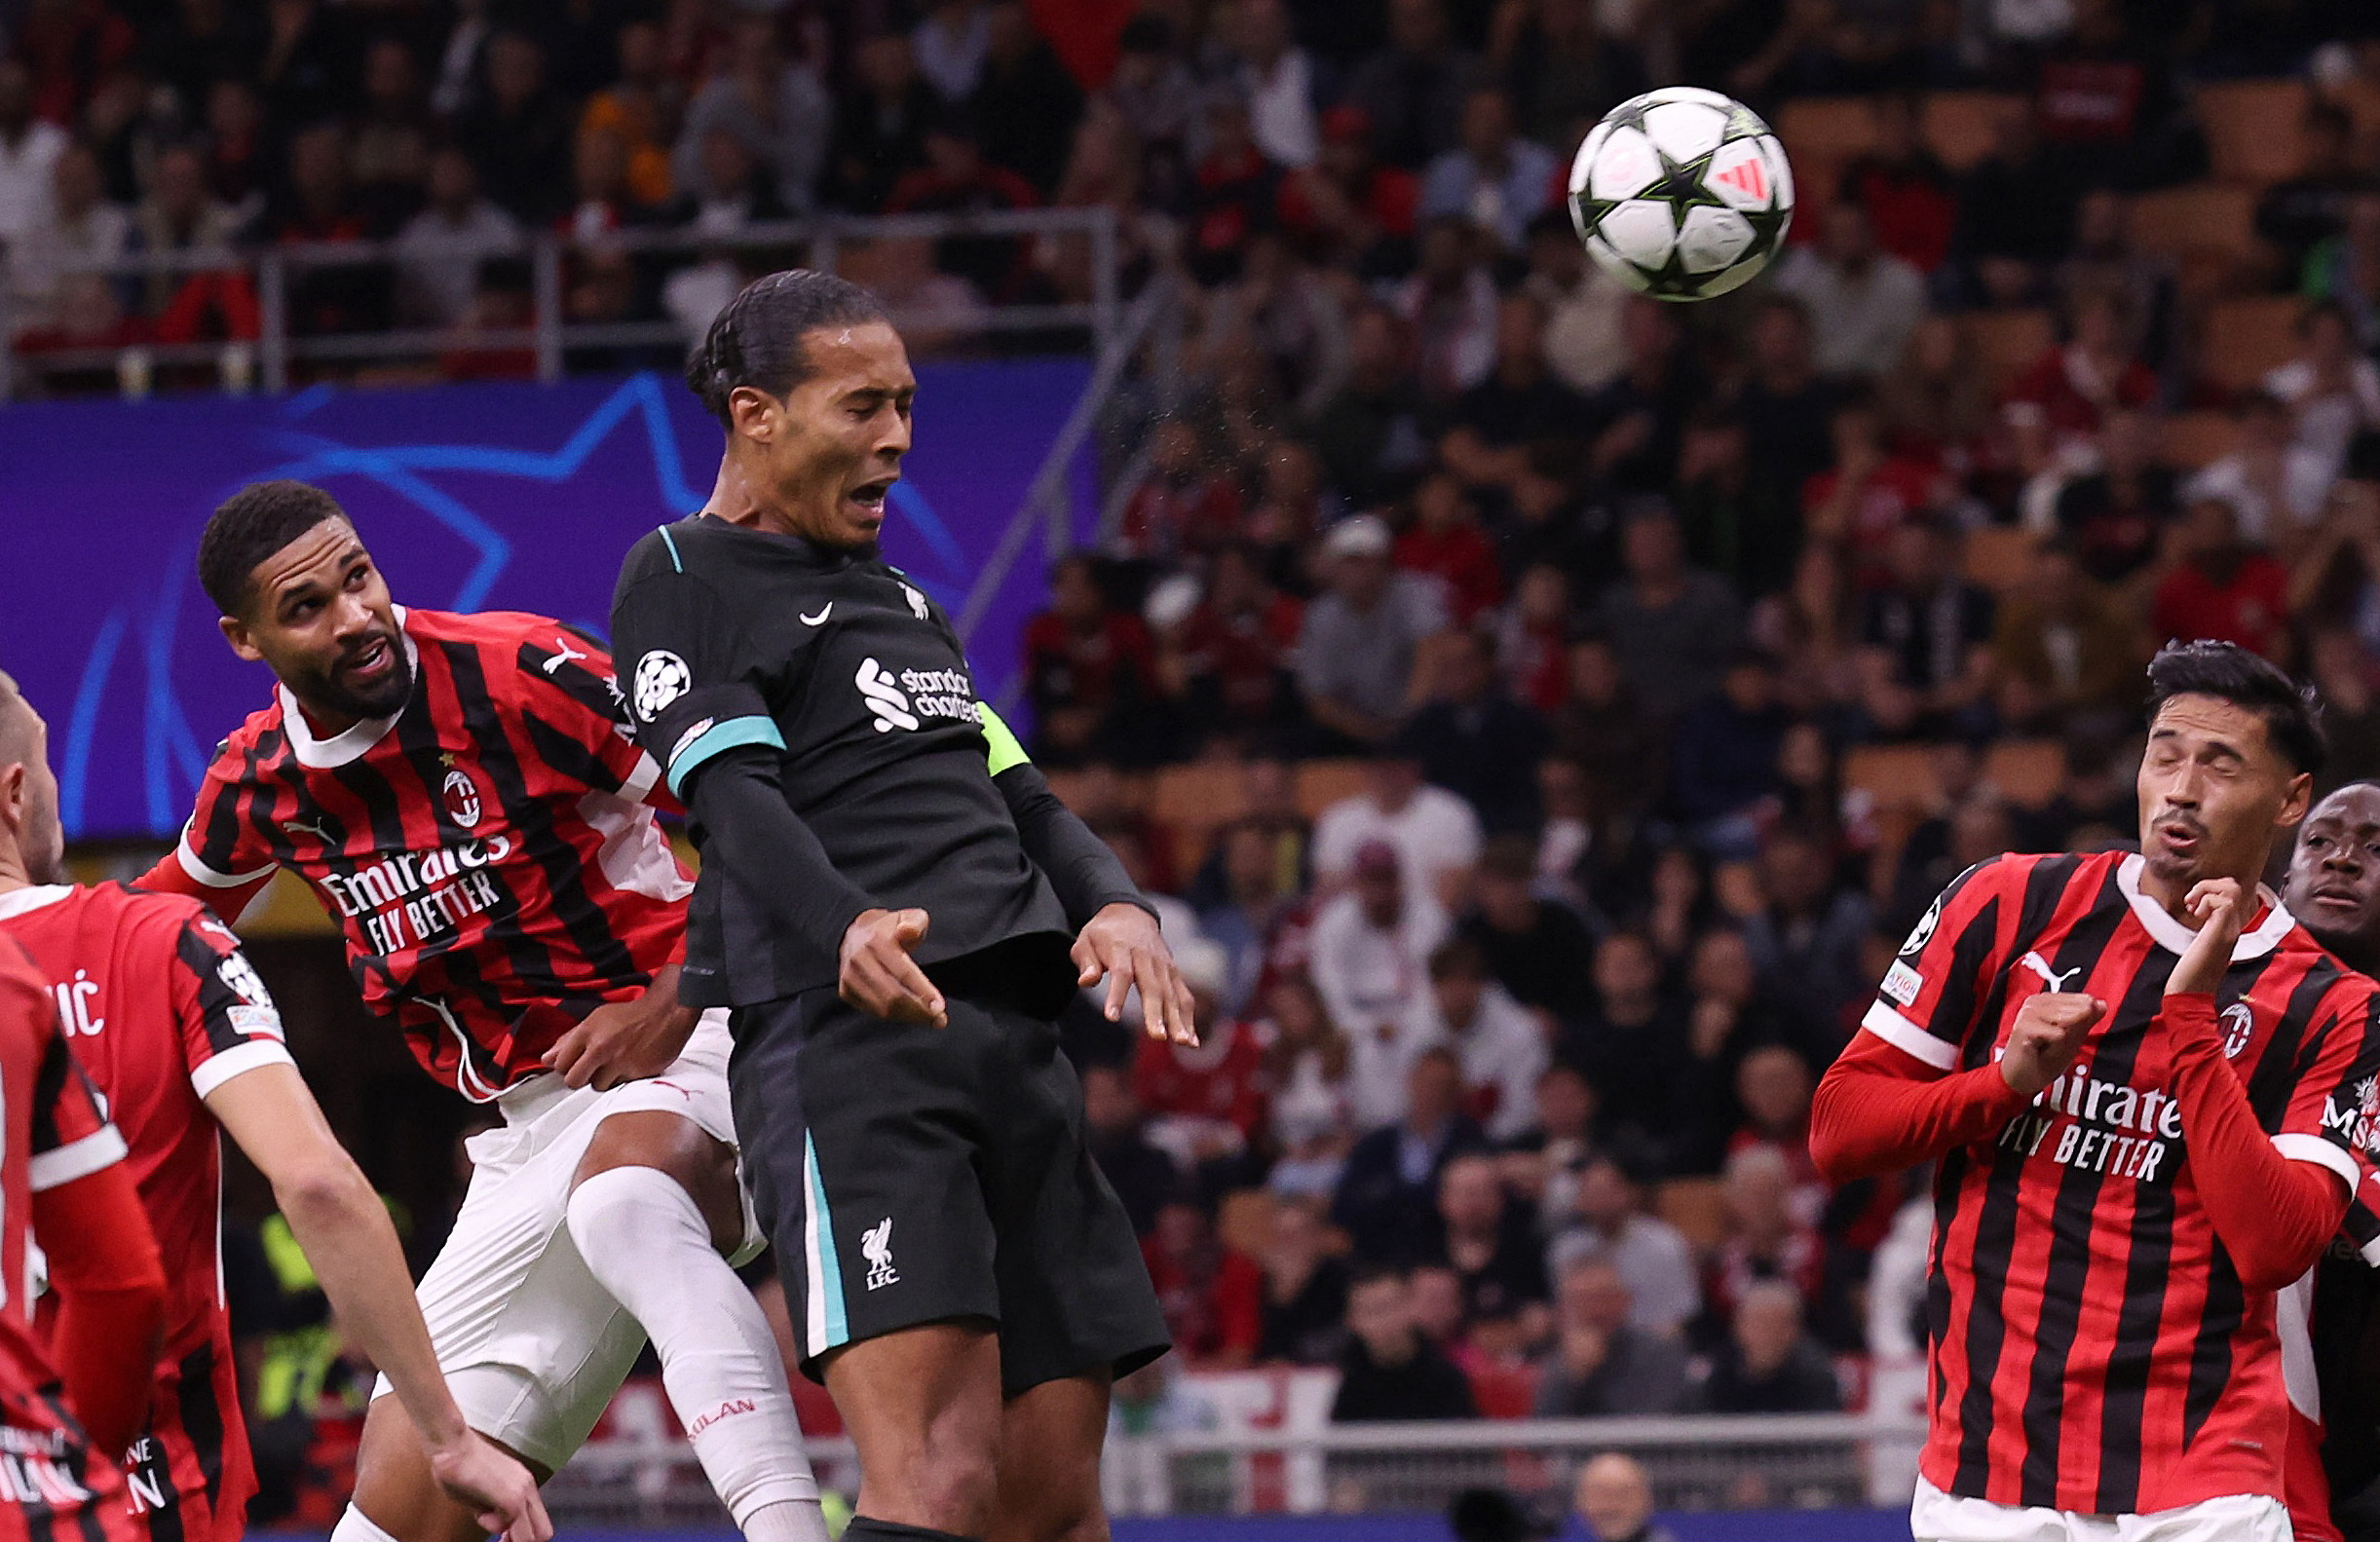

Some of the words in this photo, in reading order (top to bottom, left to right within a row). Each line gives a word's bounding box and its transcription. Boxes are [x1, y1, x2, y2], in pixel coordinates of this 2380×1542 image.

[900, 667, 971, 696] standa
[366, 907, 406, 957] FLY
[405, 869, 501, 941] BETTER
[45, 968, 105, 1037] IĆ
[2032, 1064, 2182, 1139] irate
[1999, 1113, 2054, 1157] FLY
[2053, 1123, 2166, 1183] BETTER
[126, 1468, 166, 1516] N
